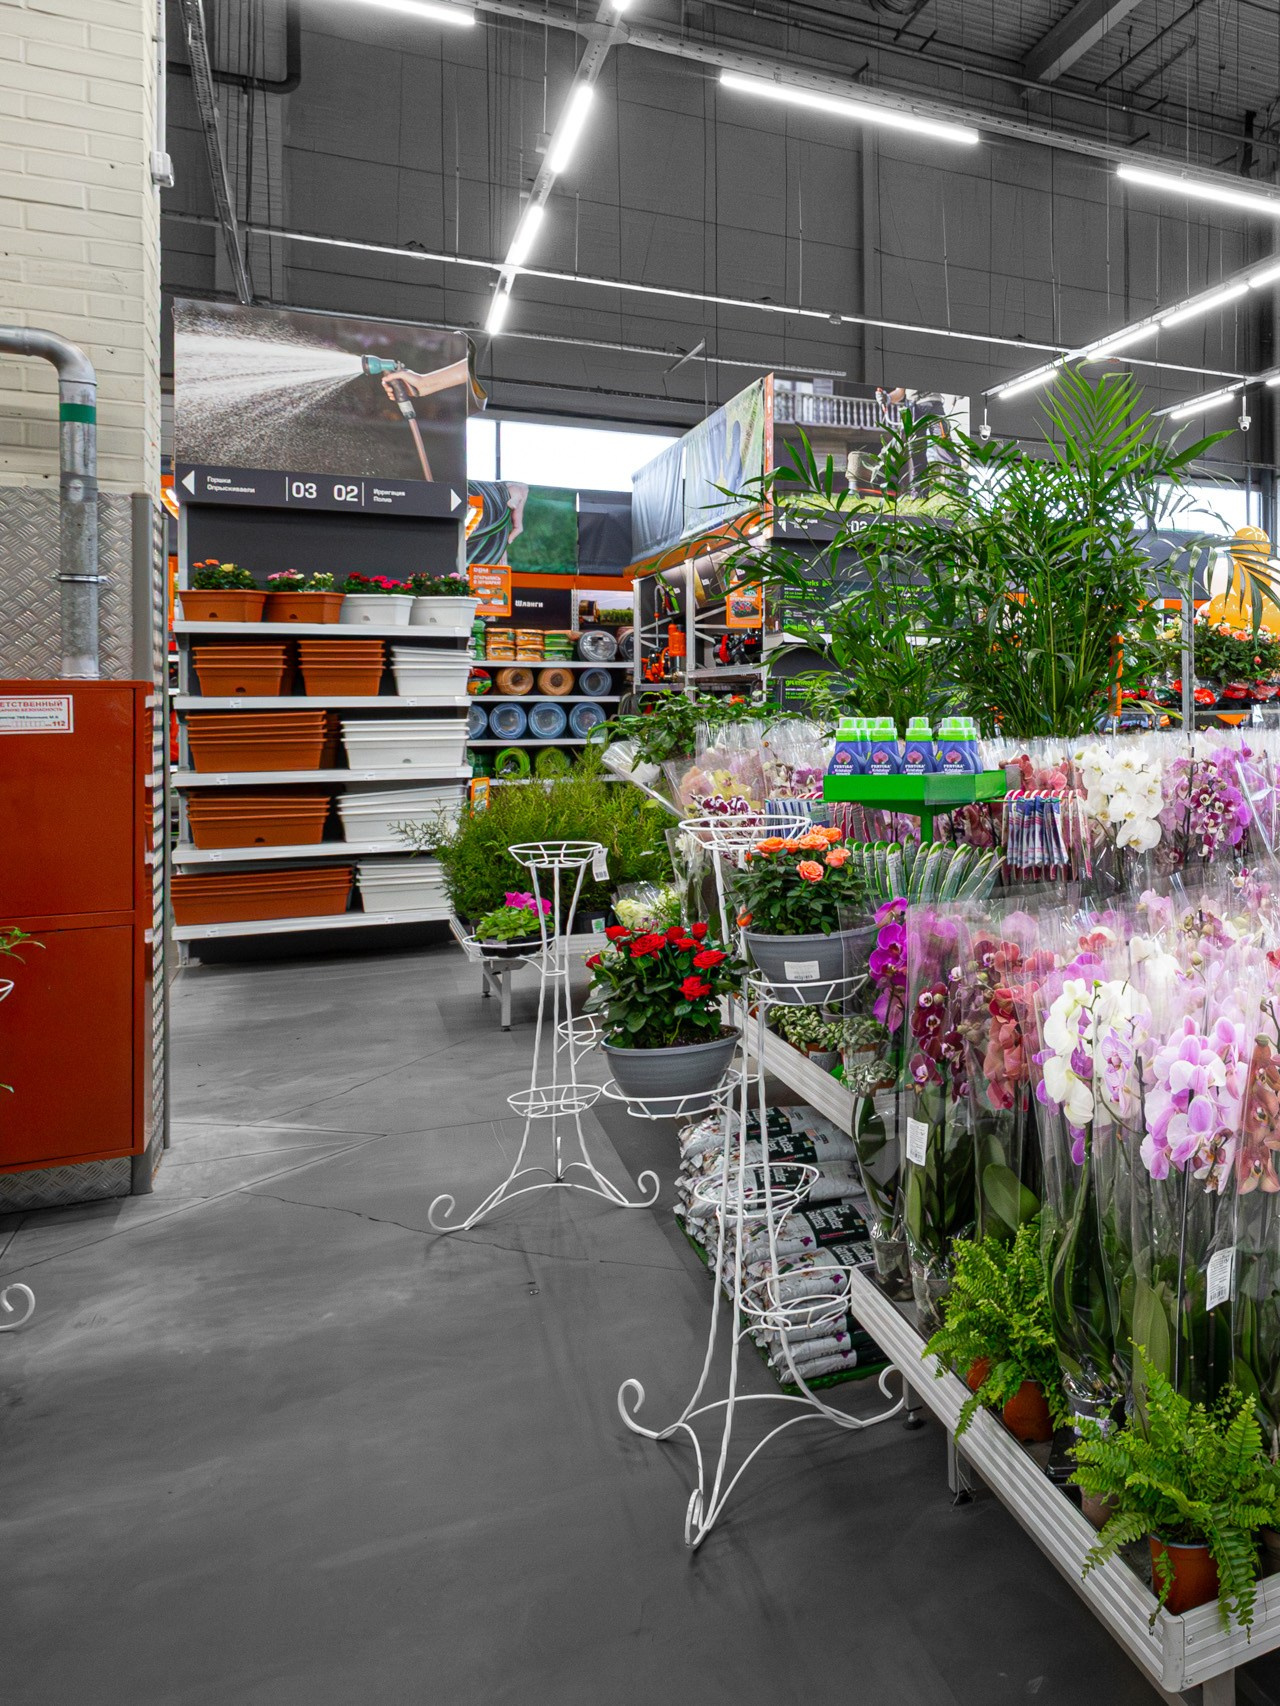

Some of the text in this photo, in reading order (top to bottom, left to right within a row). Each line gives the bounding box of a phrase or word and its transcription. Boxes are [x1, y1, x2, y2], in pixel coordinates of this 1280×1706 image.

[291, 482, 317, 499] 03
[333, 484, 358, 502] 02
[515, 600, 544, 608] Шланги
